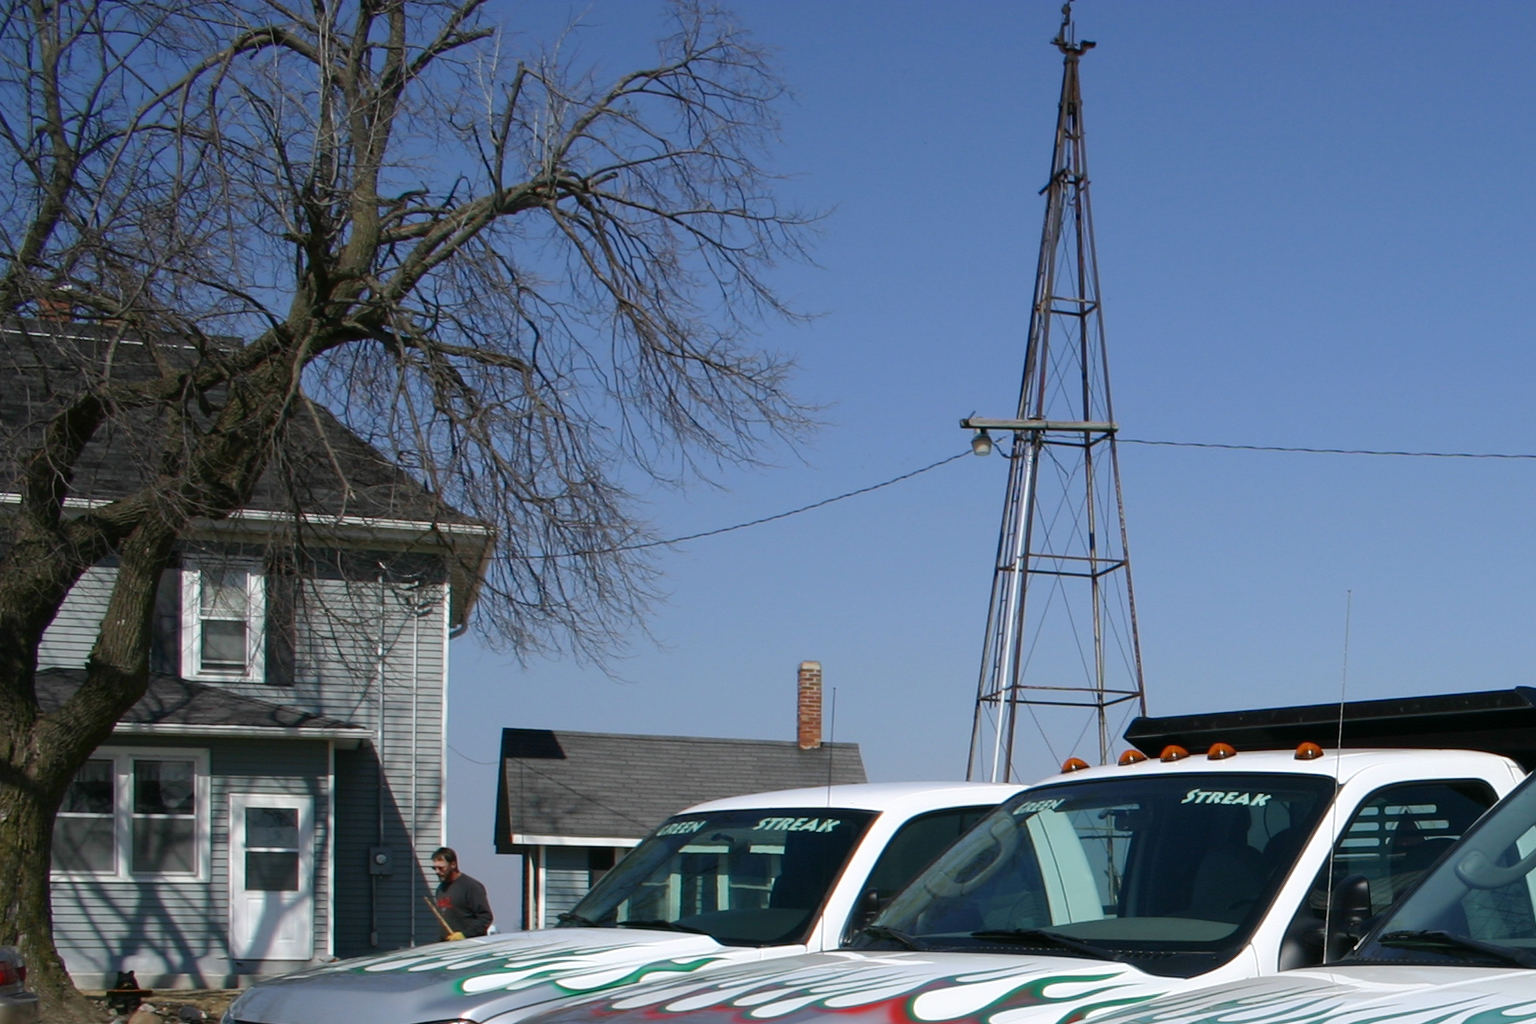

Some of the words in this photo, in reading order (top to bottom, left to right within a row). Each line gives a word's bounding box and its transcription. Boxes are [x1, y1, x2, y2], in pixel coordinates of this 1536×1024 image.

[1013, 798, 1065, 815] GREEN
[1181, 788, 1271, 807] STREAK
[656, 820, 707, 837] GREEN
[752, 817, 841, 834] STREAK
